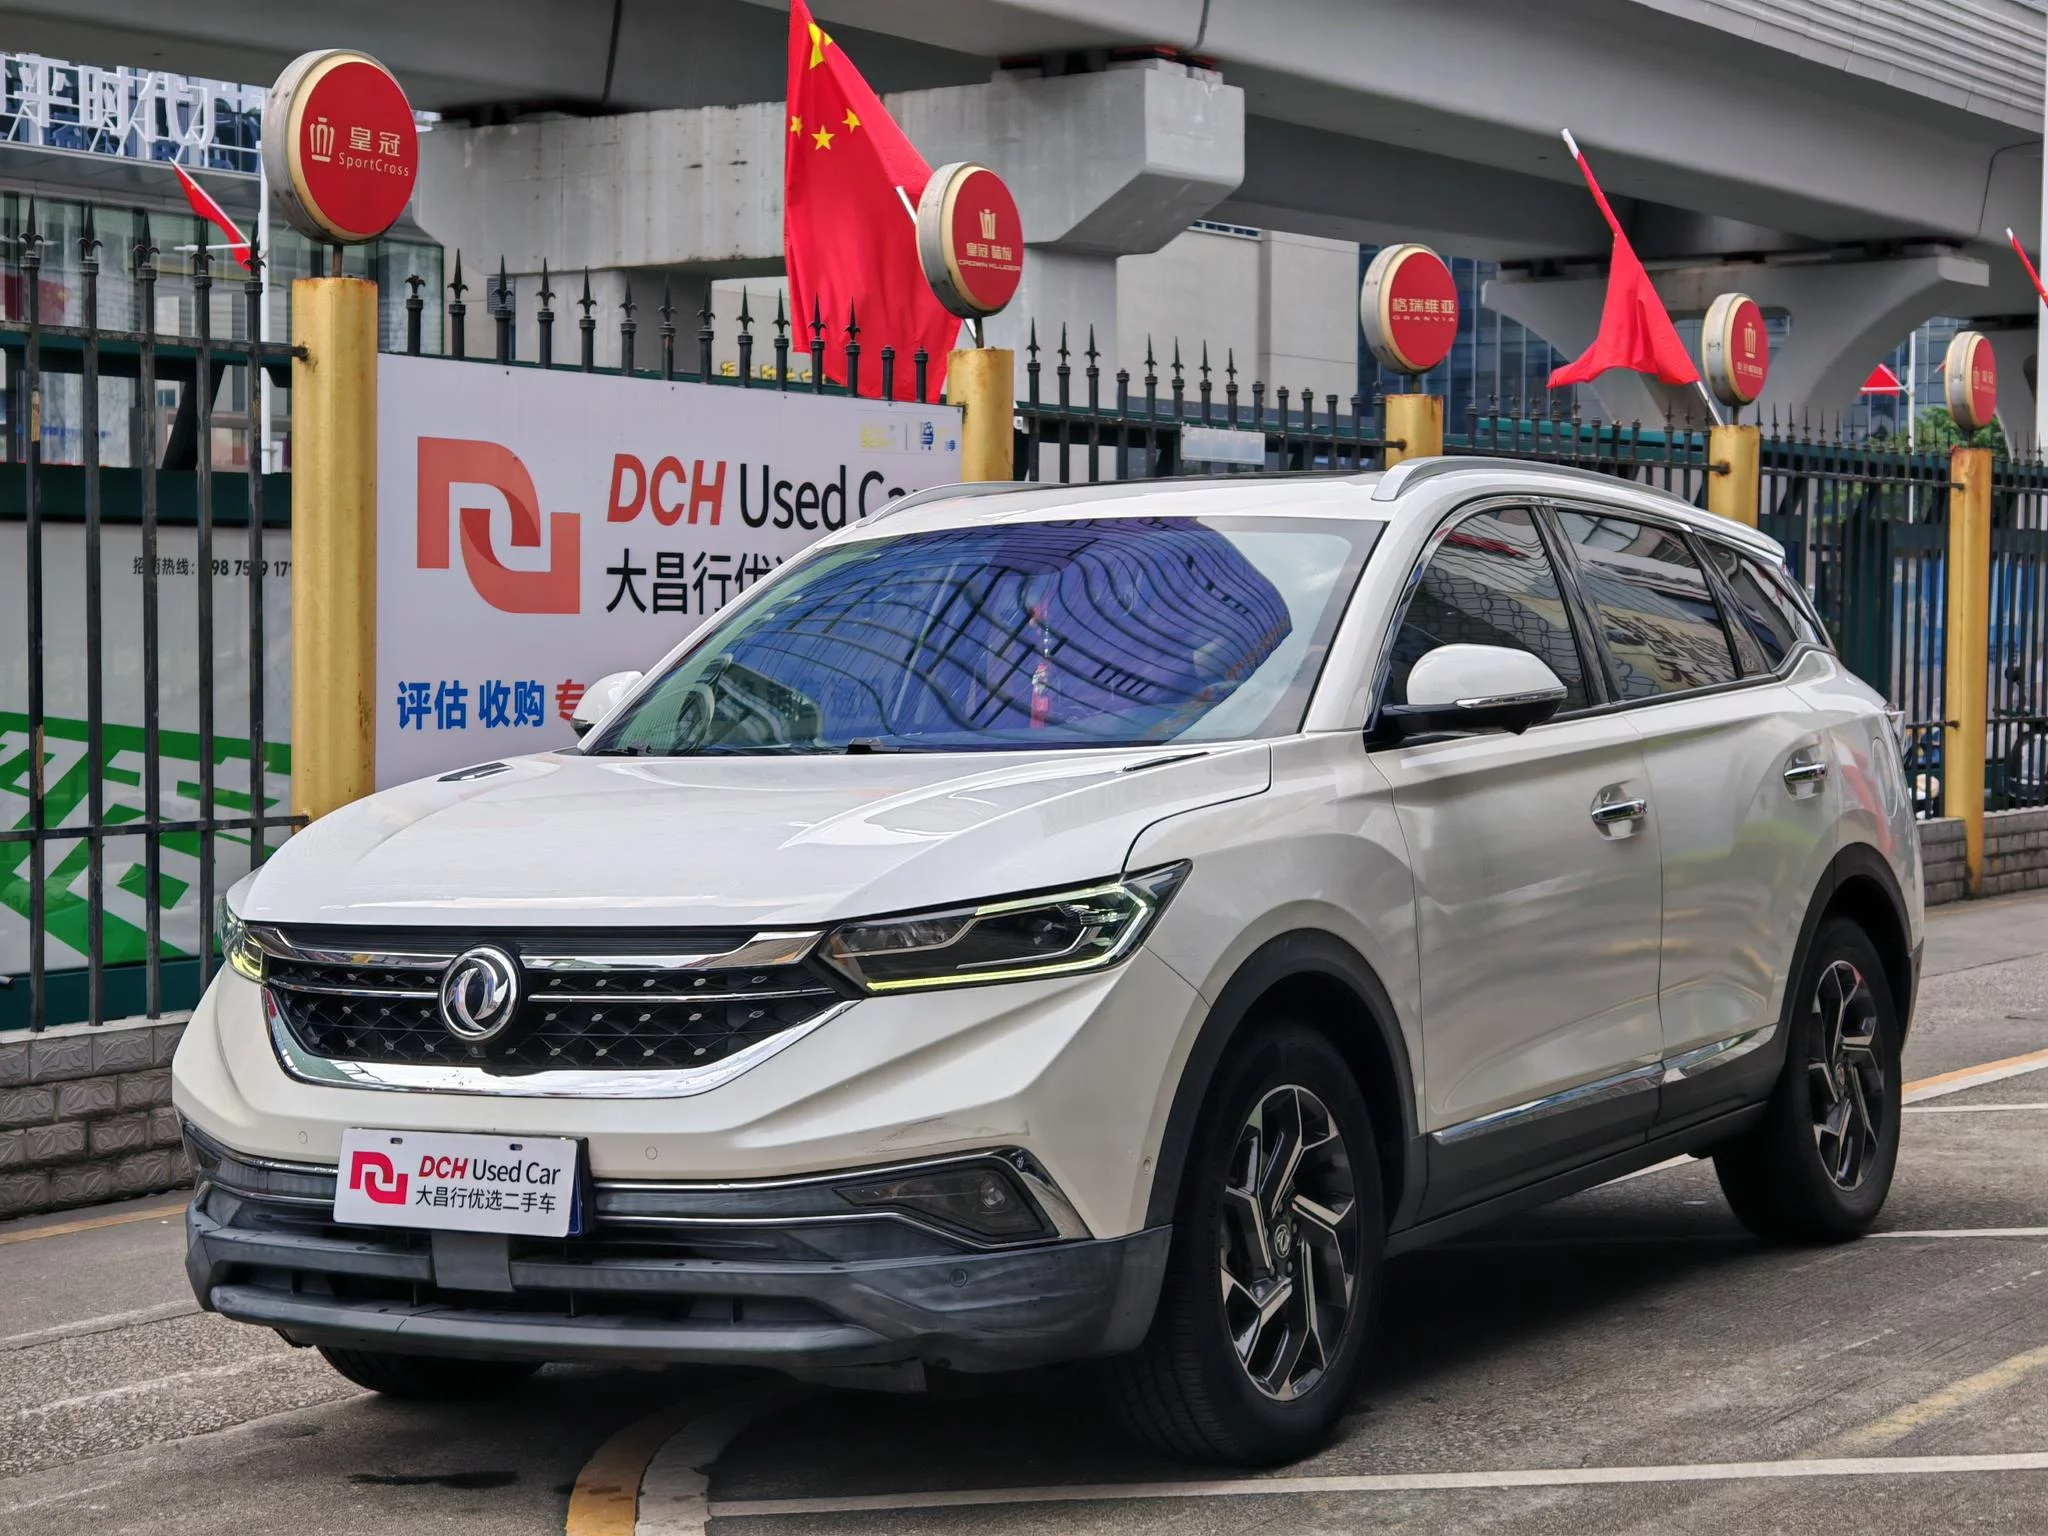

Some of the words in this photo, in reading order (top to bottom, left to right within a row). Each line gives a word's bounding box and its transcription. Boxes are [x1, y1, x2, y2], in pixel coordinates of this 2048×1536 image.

[349, 126, 401, 157] 皇冠
[338, 151, 410, 177] SportCross
[1392, 297, 1456, 314] 格瑞维亚
[607, 453, 727, 527] DCH
[740, 463, 847, 532] Used
[397, 680, 468, 730] 评估
[479, 680, 545, 728] 收购
[418, 1155, 469, 1180] DCH
[473, 1158, 522, 1183] Used
[525, 1161, 561, 1185] Car
[415, 1185, 557, 1215] 大昌行优选二手车
